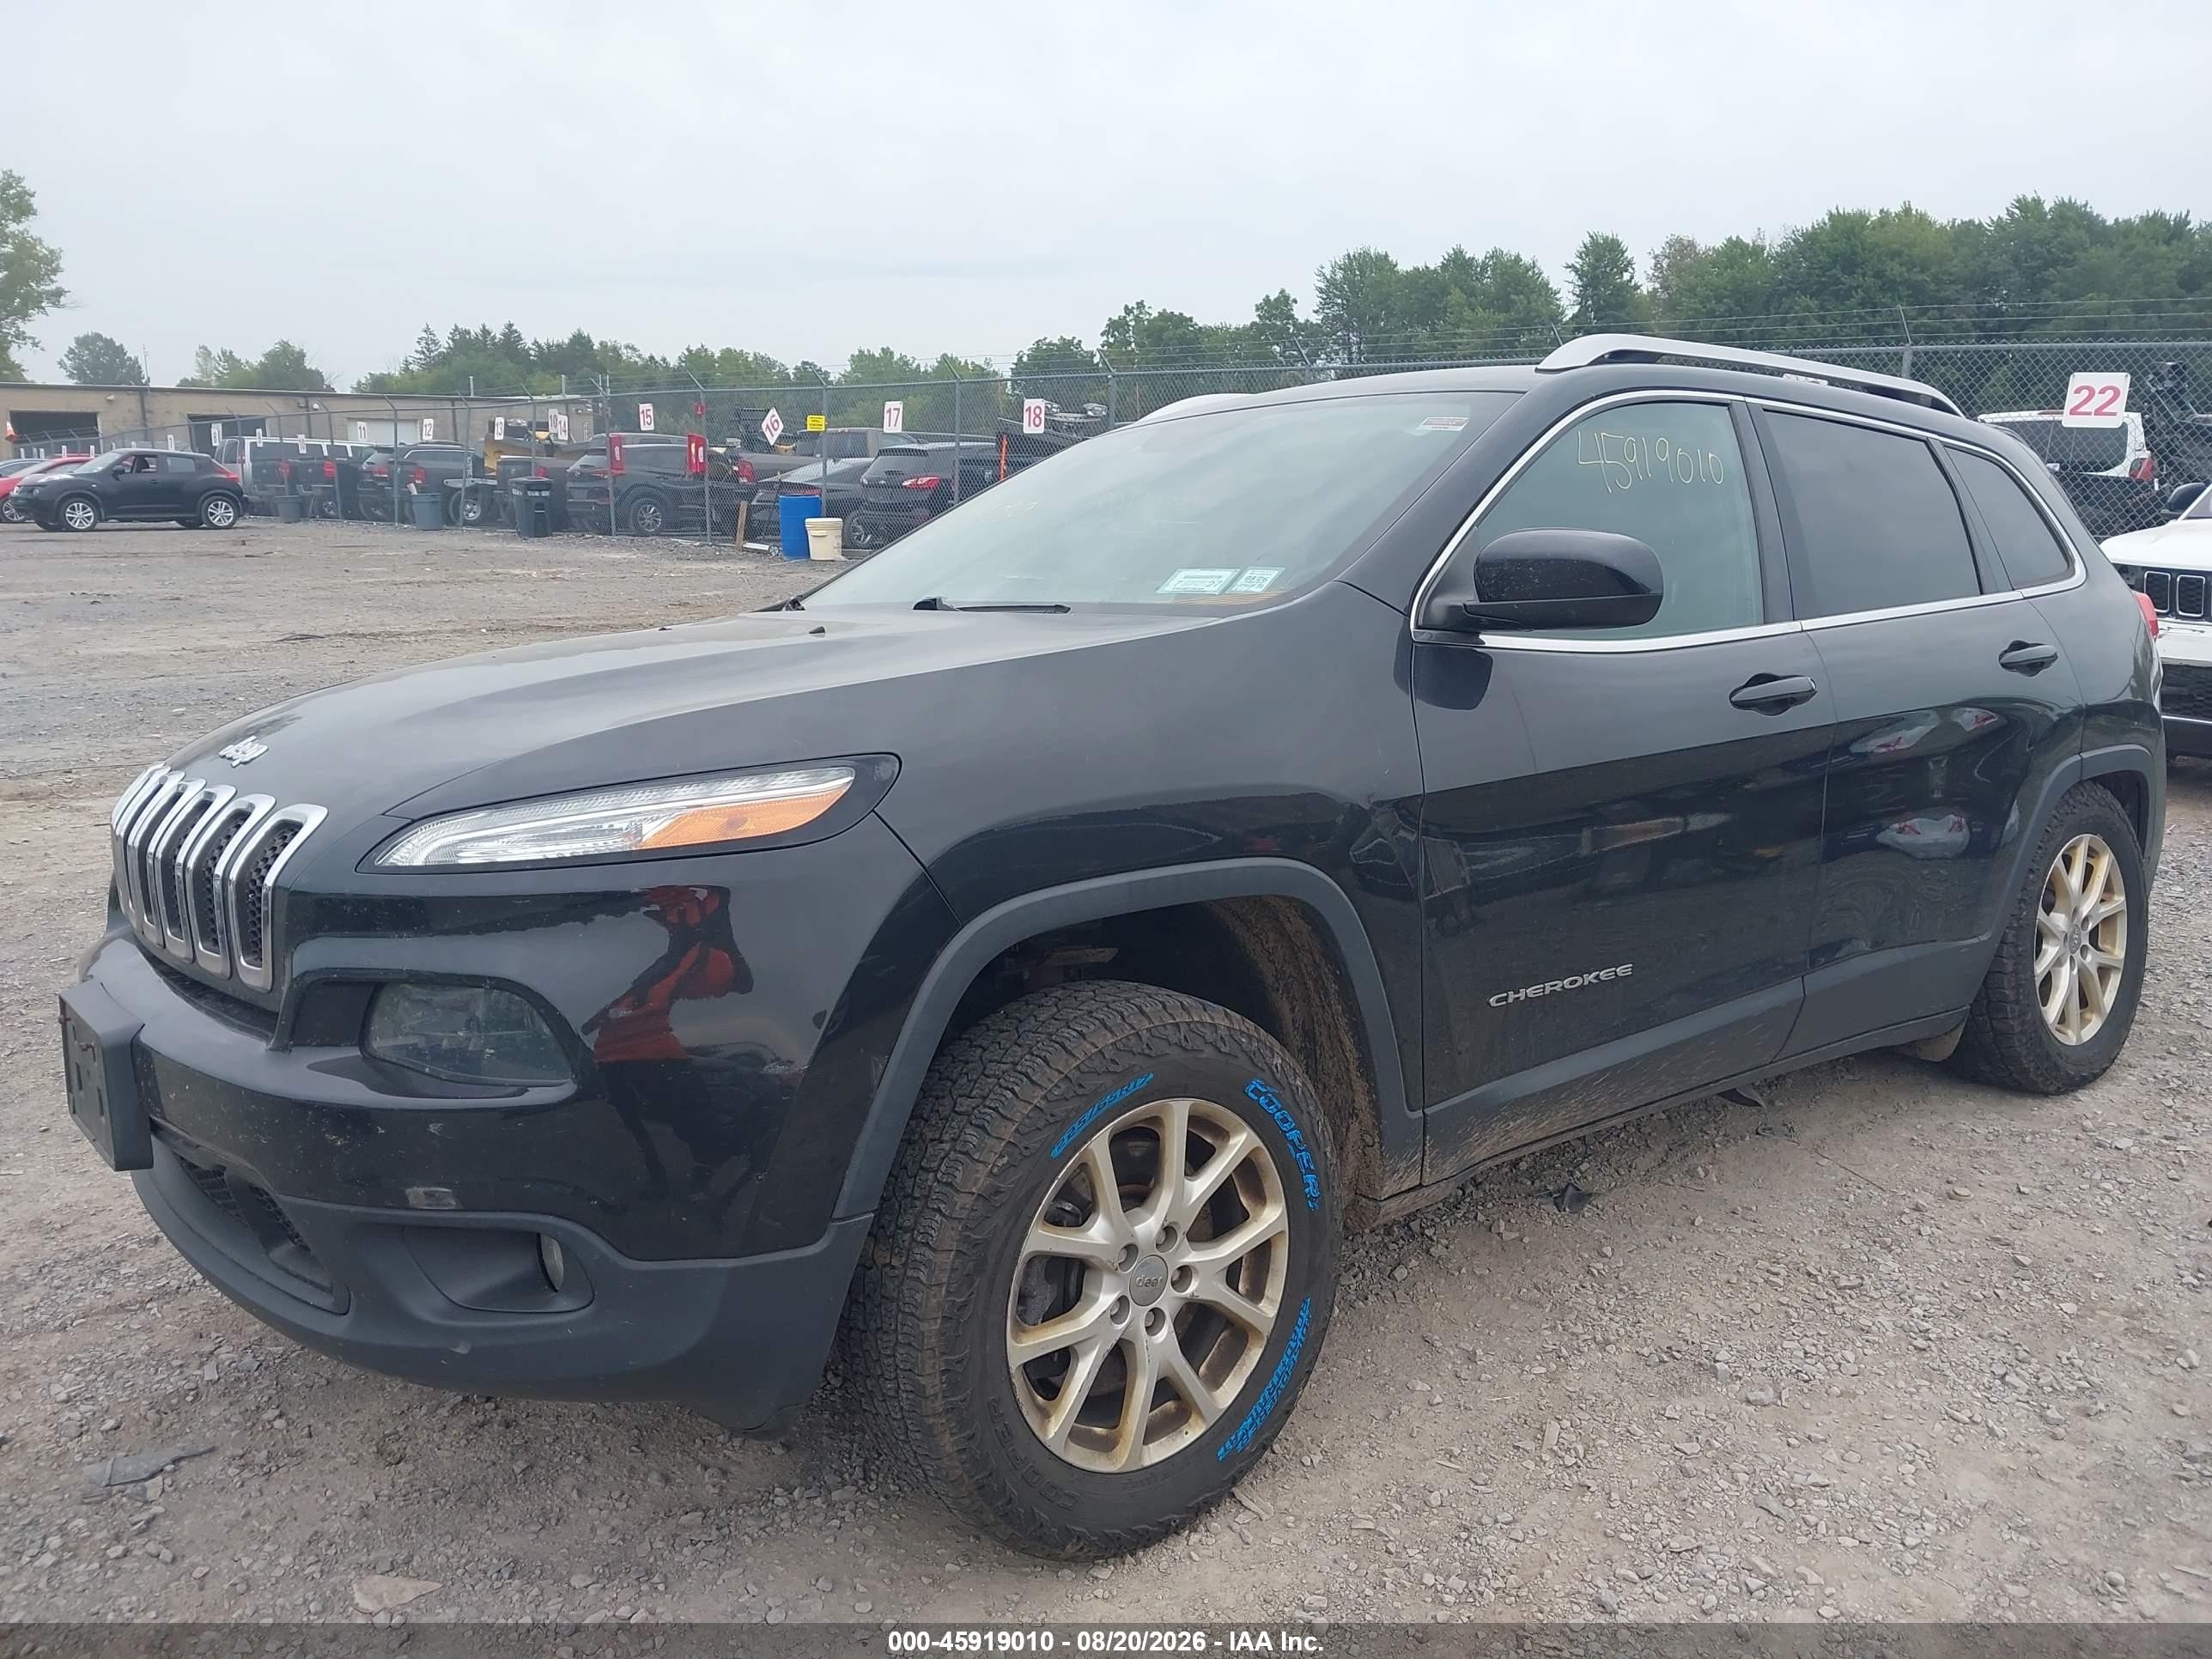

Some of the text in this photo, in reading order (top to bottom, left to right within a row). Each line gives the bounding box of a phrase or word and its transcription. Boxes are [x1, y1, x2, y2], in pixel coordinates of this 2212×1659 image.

[2069, 385, 2121, 416] 22
[550, 414, 558, 428] 10
[558, 419, 567, 434] 14
[640, 409, 653, 427] 15
[764, 414, 781, 438] 16
[885, 408, 901, 428] 17
[1024, 405, 1042, 428] 18
[358, 425, 367, 440] 11
[424, 422, 432, 437] 12
[495, 420, 504, 436] 13
[1577, 430, 1724, 494] 45919010
[1488, 963, 1633, 1007] CHEROKEE
[1245, 1079, 1320, 1202] COOPER
[987, 1395, 1081, 1512] COOPER
